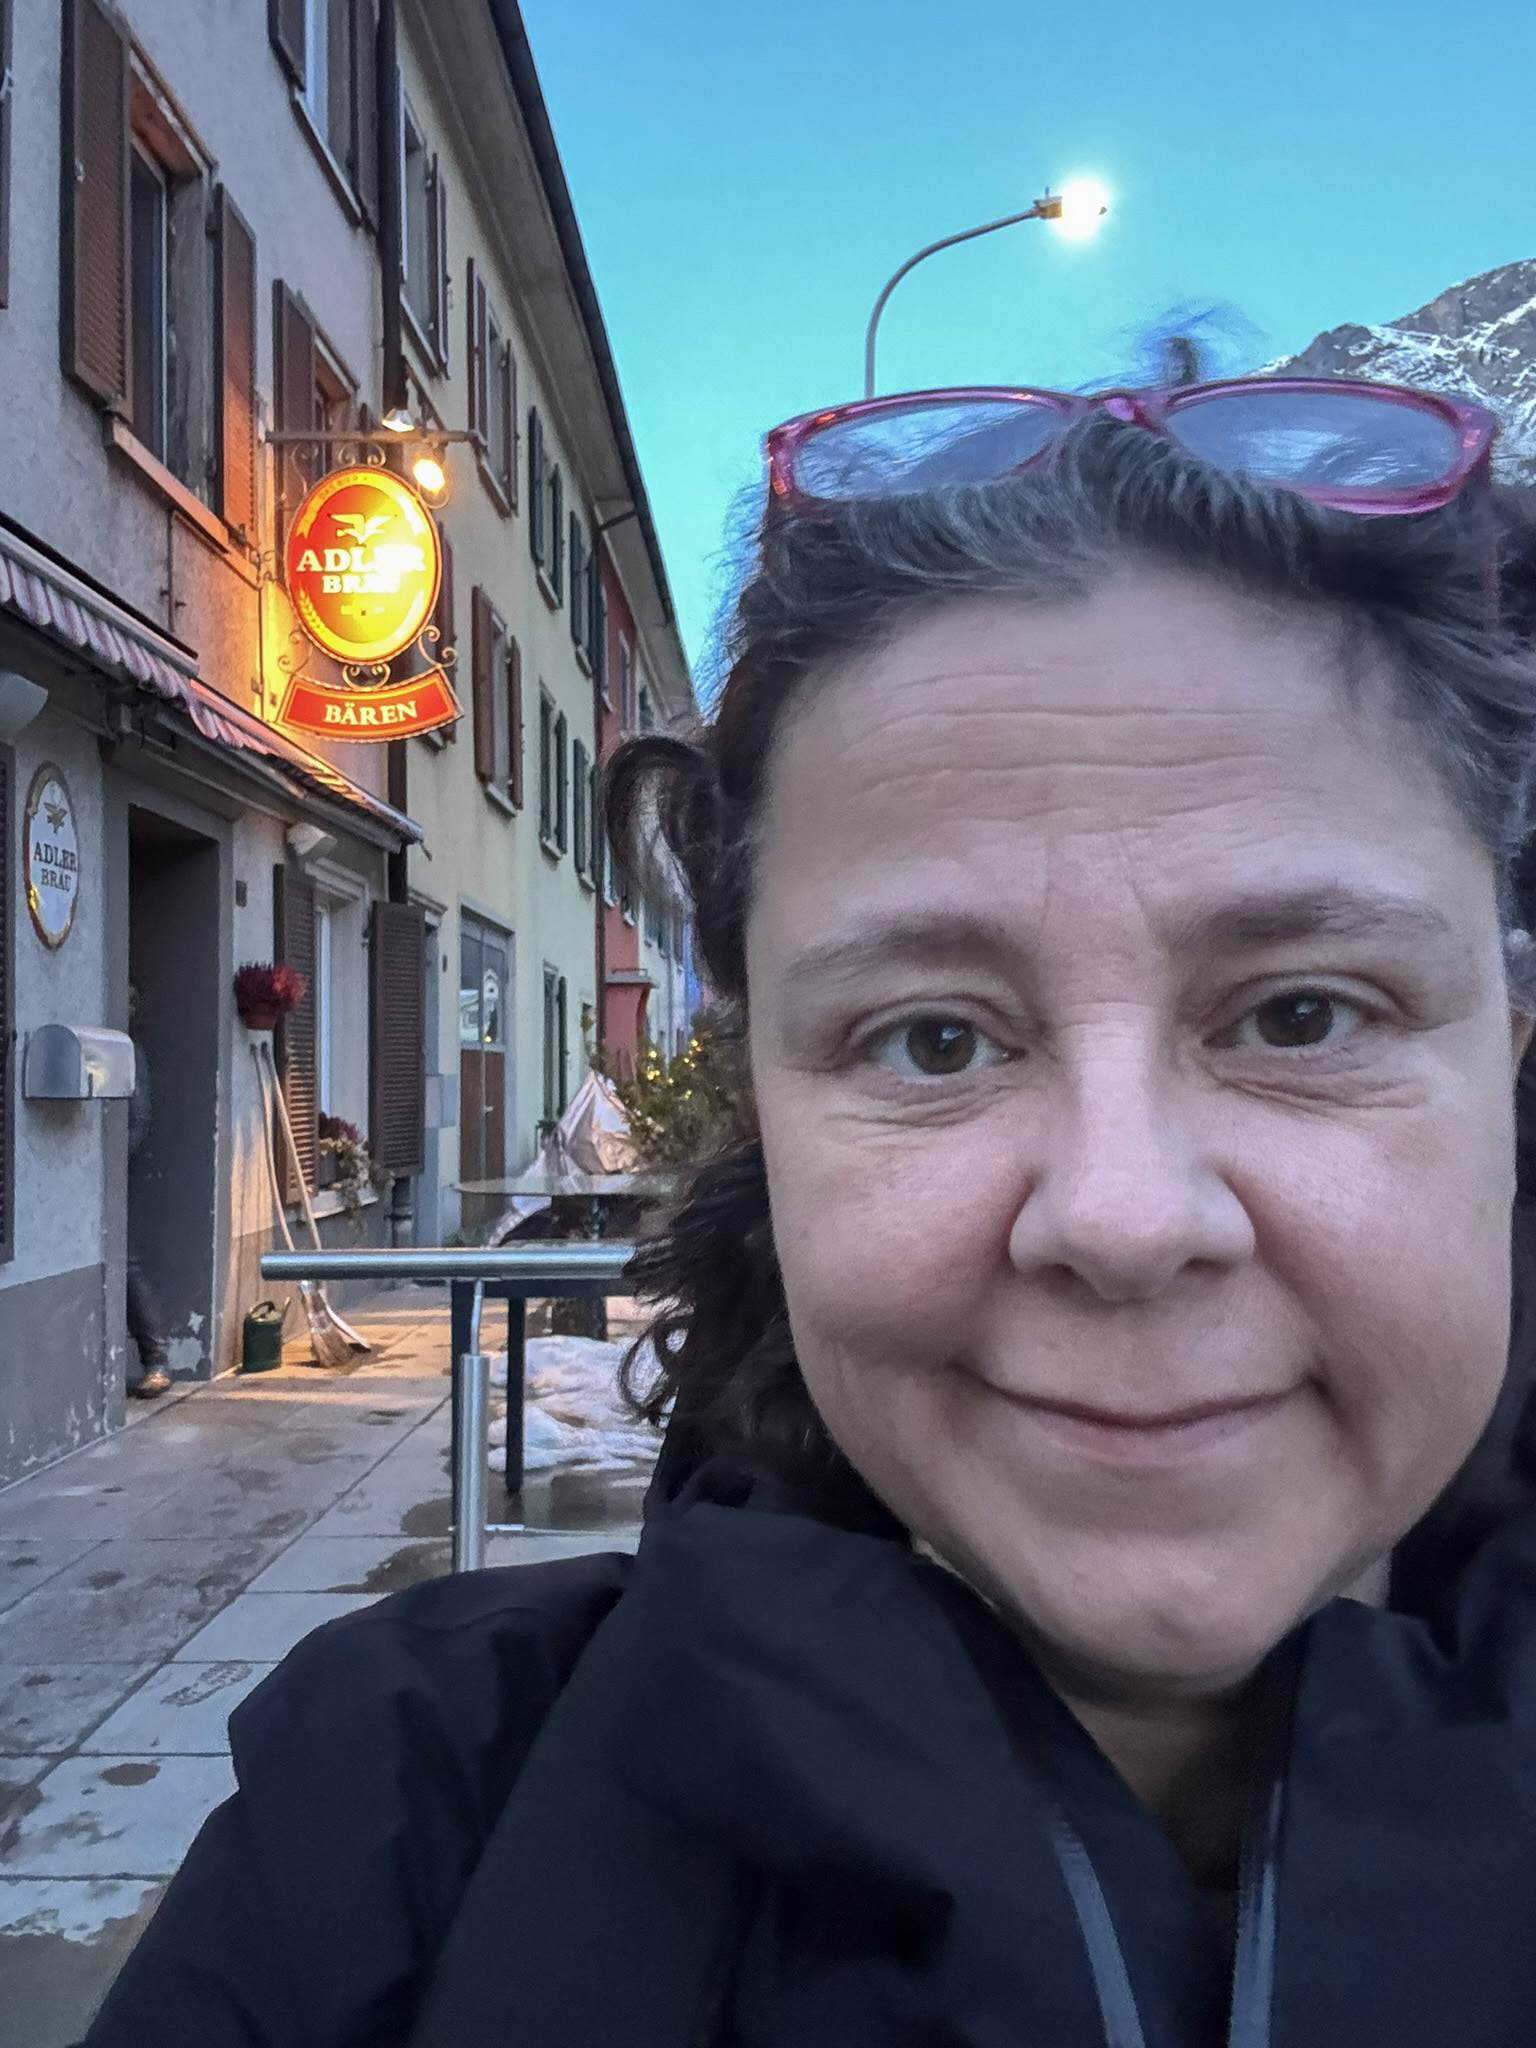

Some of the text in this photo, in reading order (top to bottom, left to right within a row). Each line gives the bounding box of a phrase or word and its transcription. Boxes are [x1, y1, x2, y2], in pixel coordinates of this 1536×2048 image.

[296, 545, 427, 573] ADLR
[322, 575, 401, 594] BR
[322, 700, 418, 726] BÄREN
[33, 841, 77, 872] ADLER
